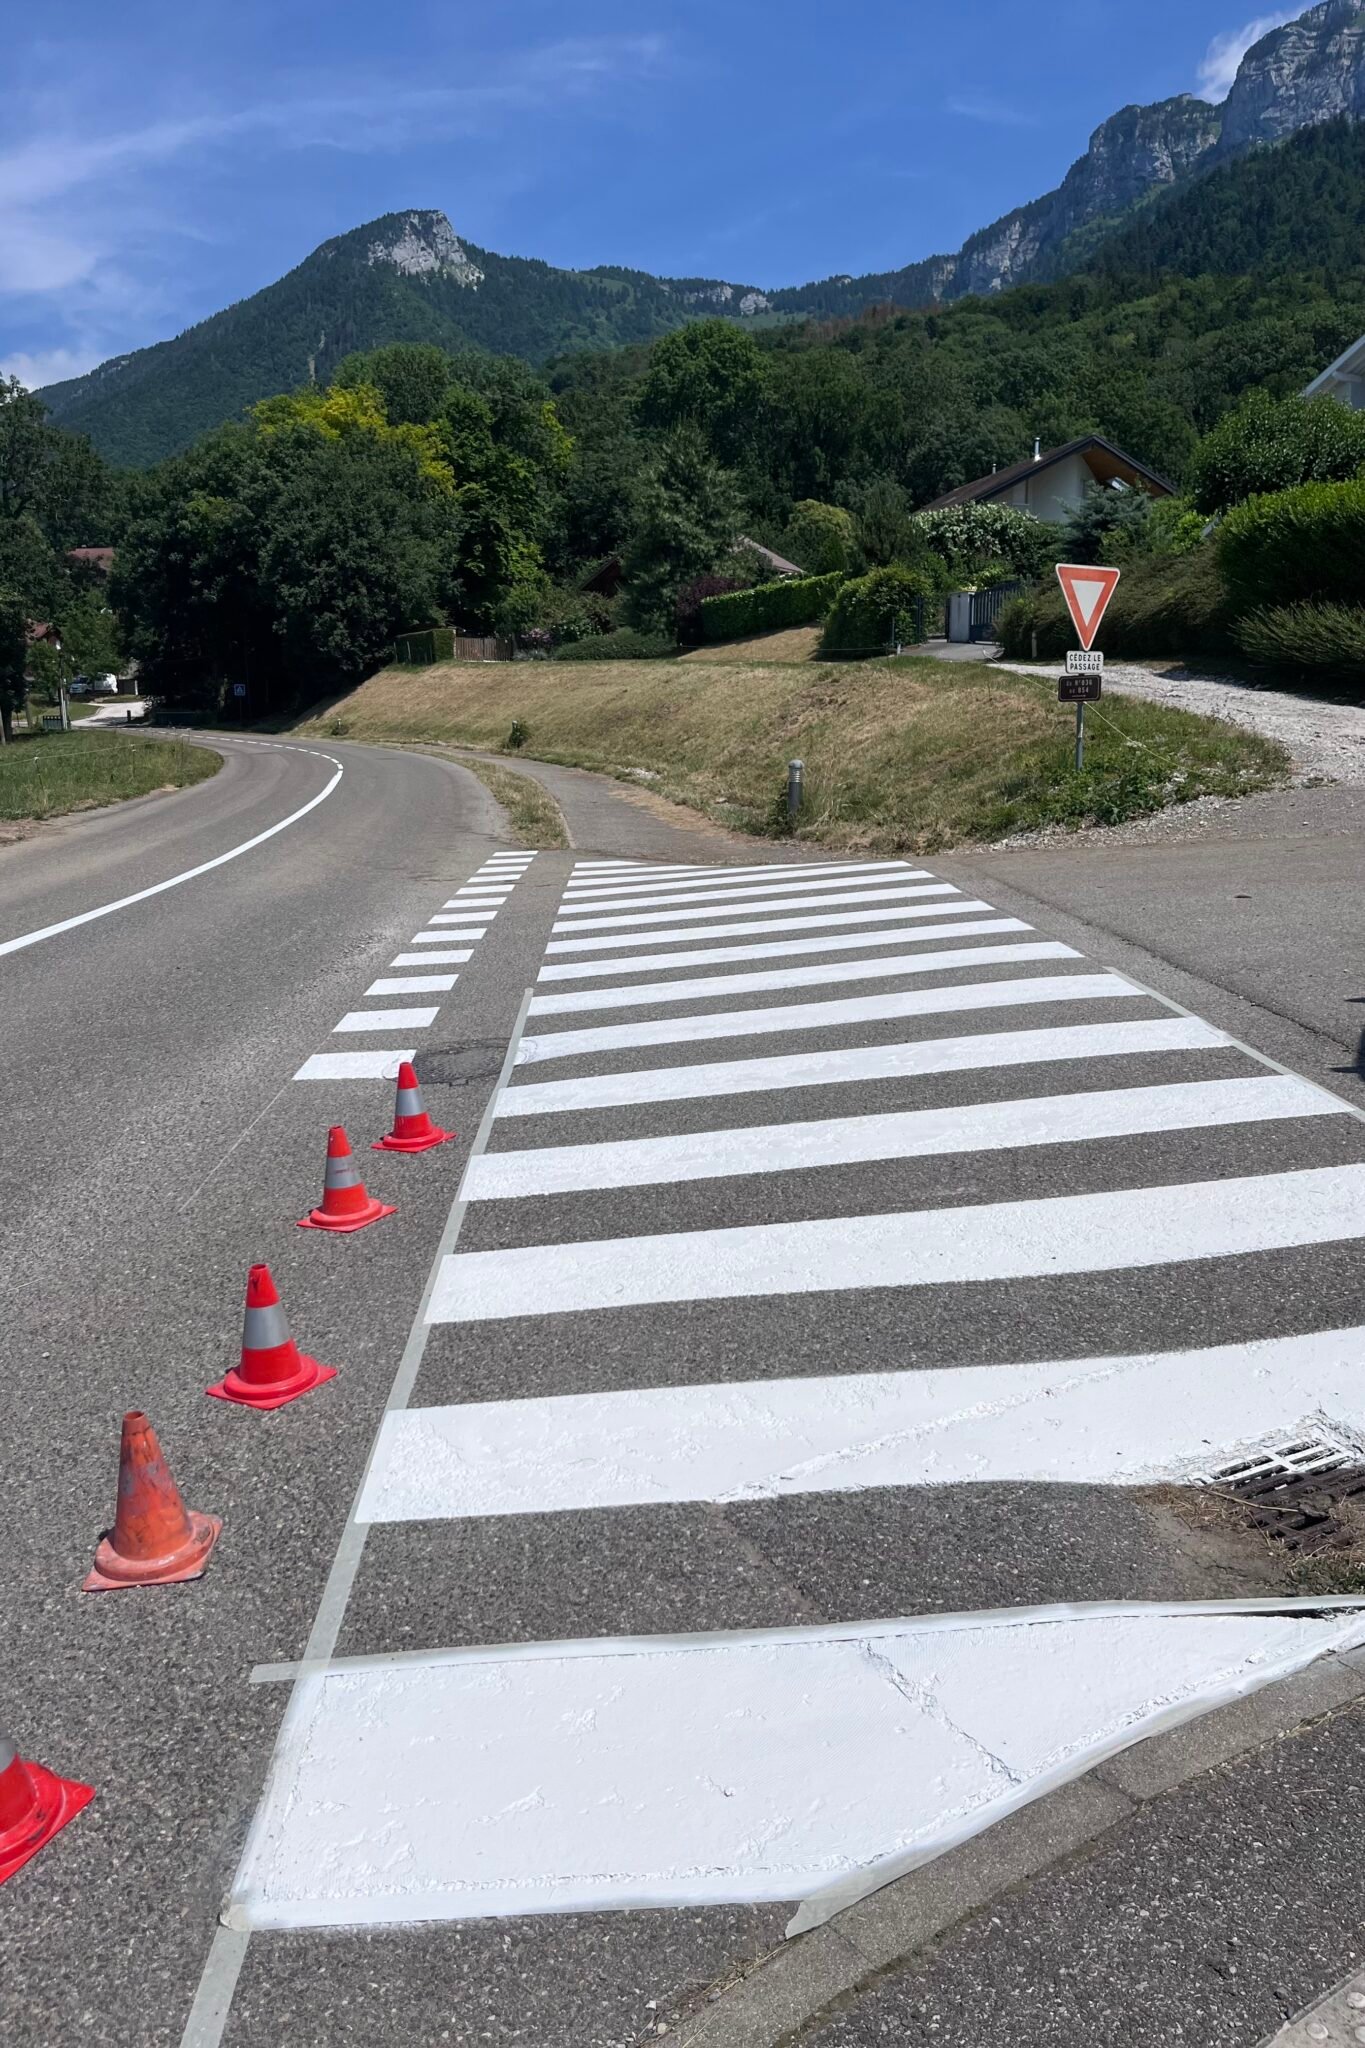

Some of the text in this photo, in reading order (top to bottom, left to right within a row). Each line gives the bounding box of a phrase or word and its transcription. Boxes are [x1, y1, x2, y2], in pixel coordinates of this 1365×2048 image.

[1069, 653, 1101, 662] CÉDEZ LE
[1070, 663, 1100, 671] PASSAGE
